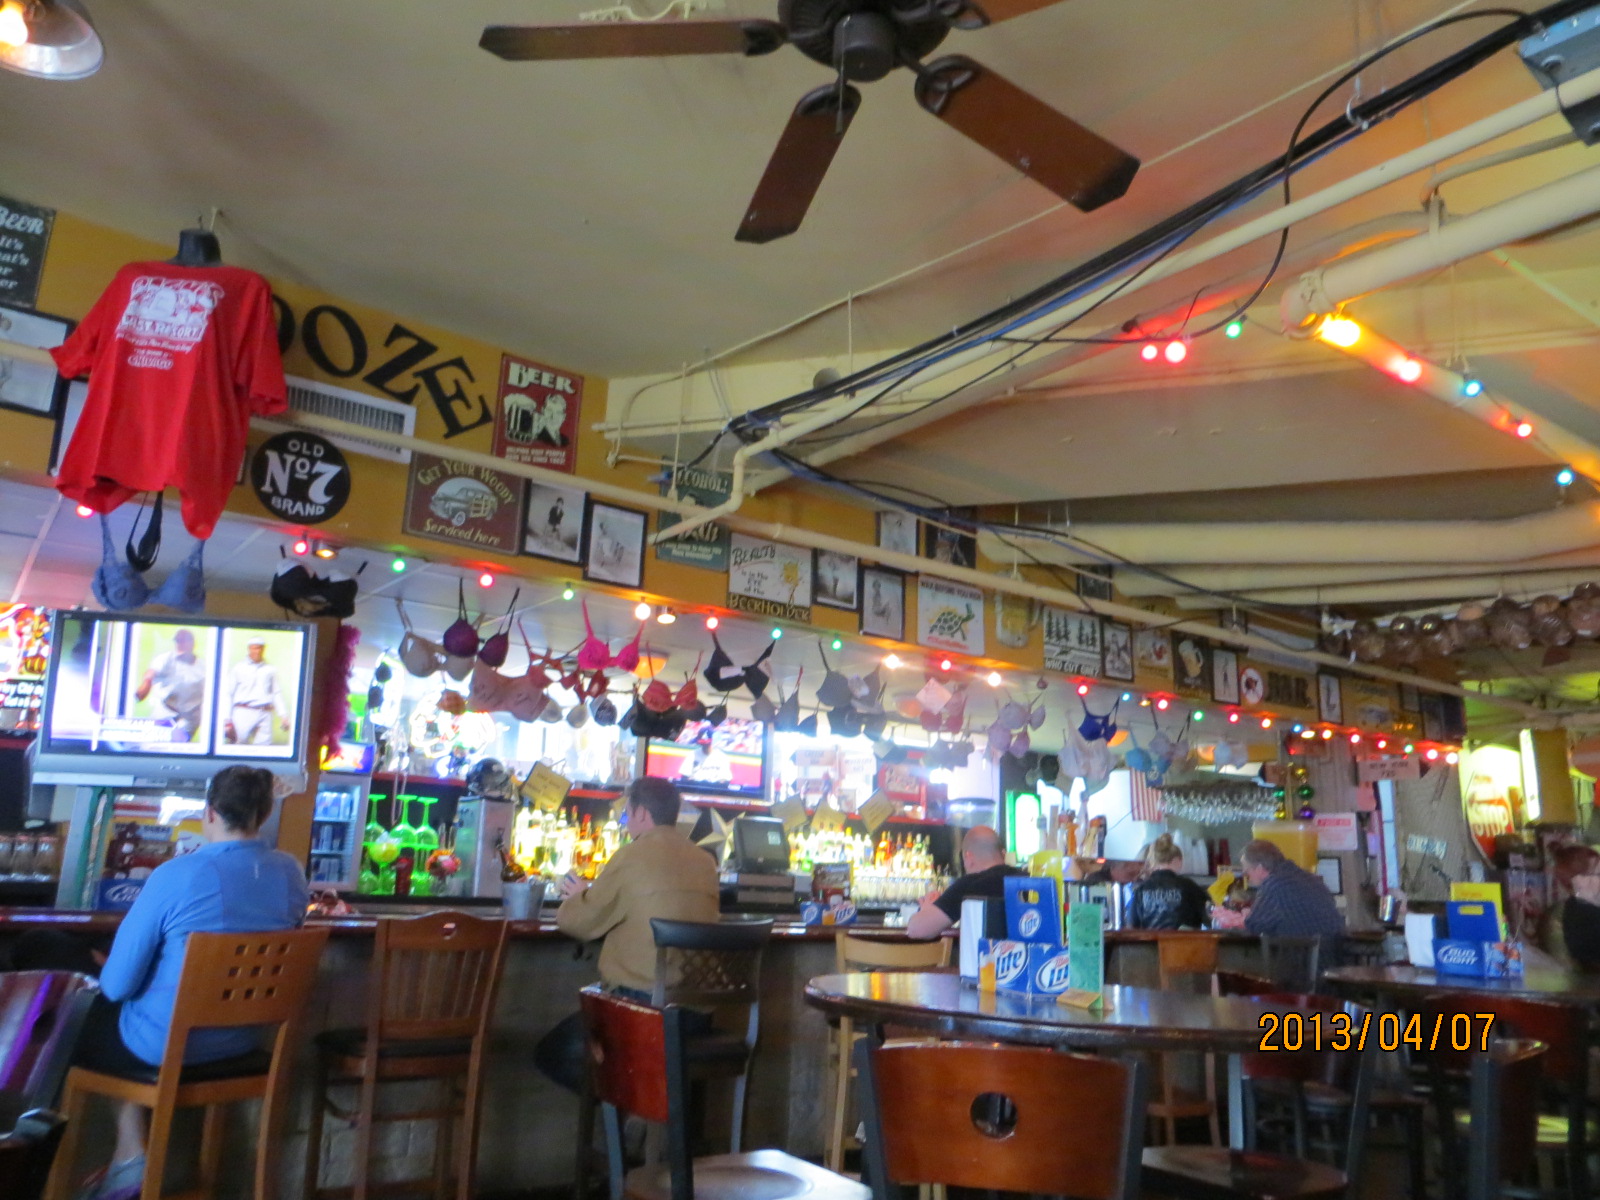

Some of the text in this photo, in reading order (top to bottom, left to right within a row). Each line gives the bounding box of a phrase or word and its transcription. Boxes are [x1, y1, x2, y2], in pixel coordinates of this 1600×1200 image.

[508, 362, 576, 394] BEER
[288, 439, 324, 458] OLD
[417, 458, 516, 504] GET YOUR WOODY
[271, 495, 325, 516] BRAND
[425, 517, 501, 546] Serviced here
[1443, 954, 1480, 965] LIGHT
[1446, 947, 1476, 956] BUD
[995, 950, 1022, 980] Lite
